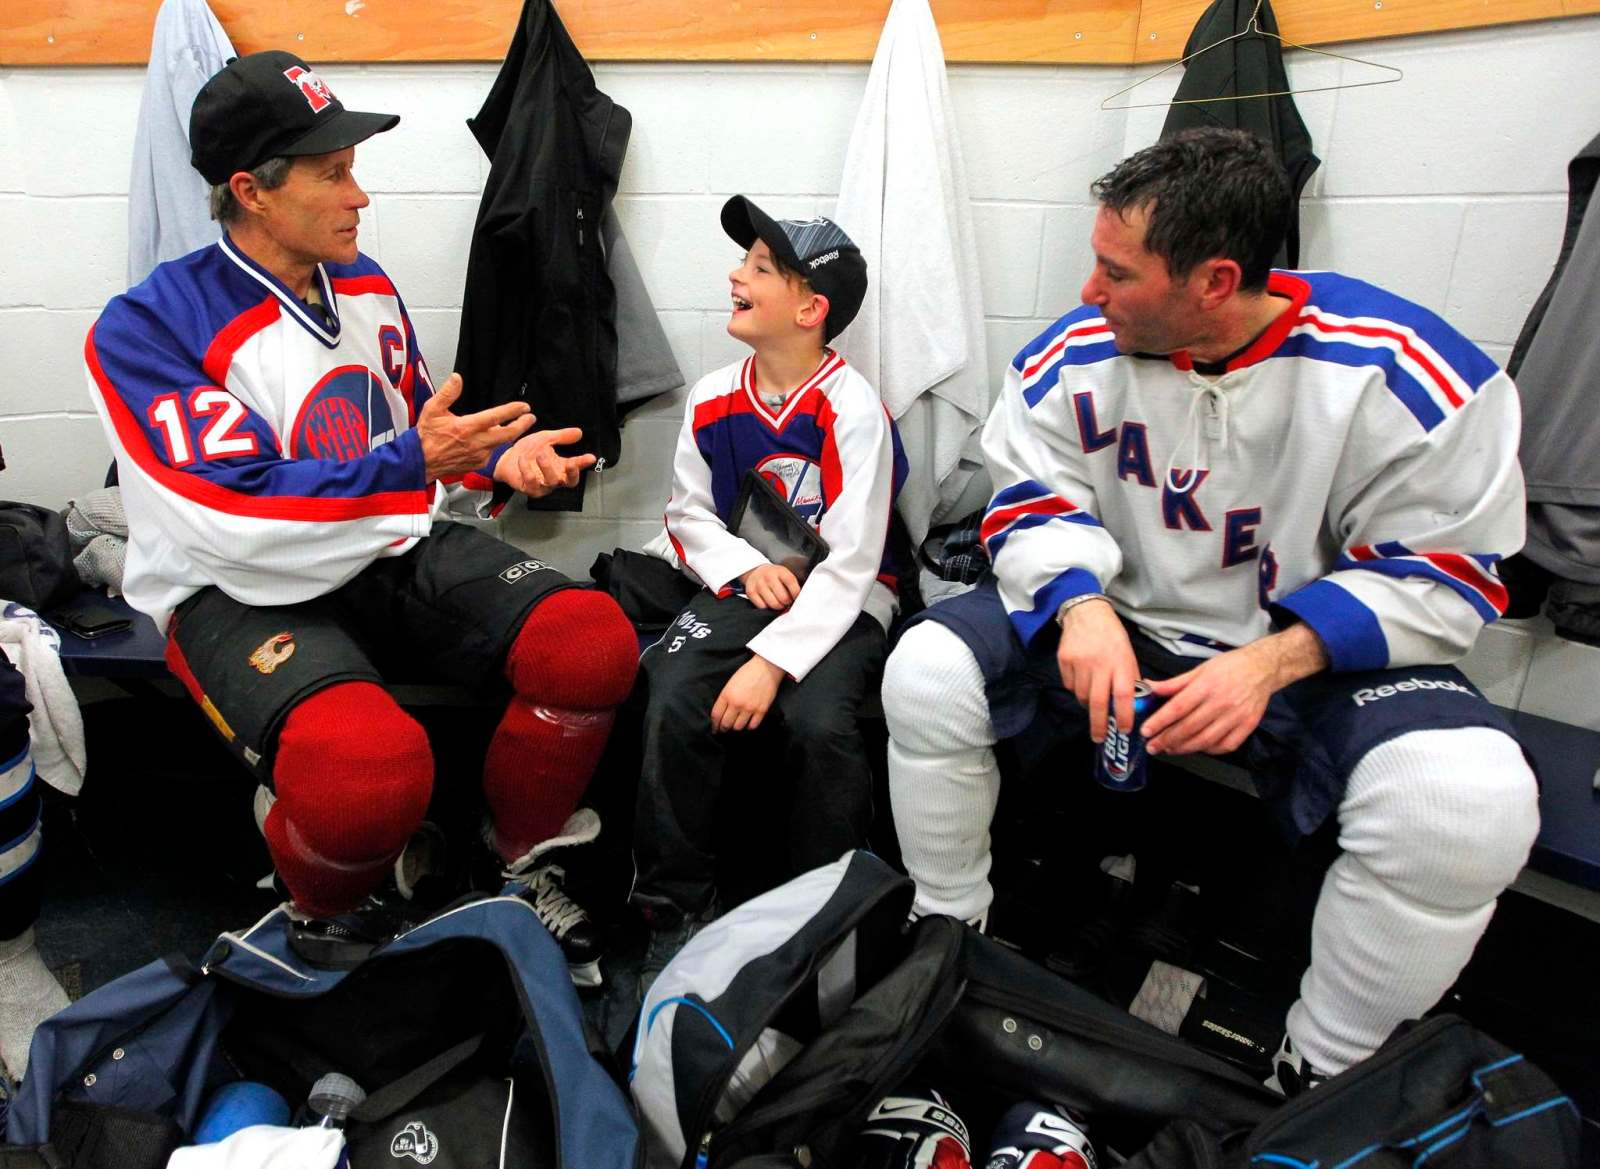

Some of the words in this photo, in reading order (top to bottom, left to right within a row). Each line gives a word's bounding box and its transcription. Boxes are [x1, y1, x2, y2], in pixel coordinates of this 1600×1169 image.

[808, 249, 840, 270] Reebok
[378, 324, 404, 389] C
[147, 386, 260, 470] 12
[668, 636, 687, 653] 5
[1352, 678, 1478, 707] Reebok
[1104, 716, 1117, 760] BUD
[1115, 732, 1129, 772] LIG
